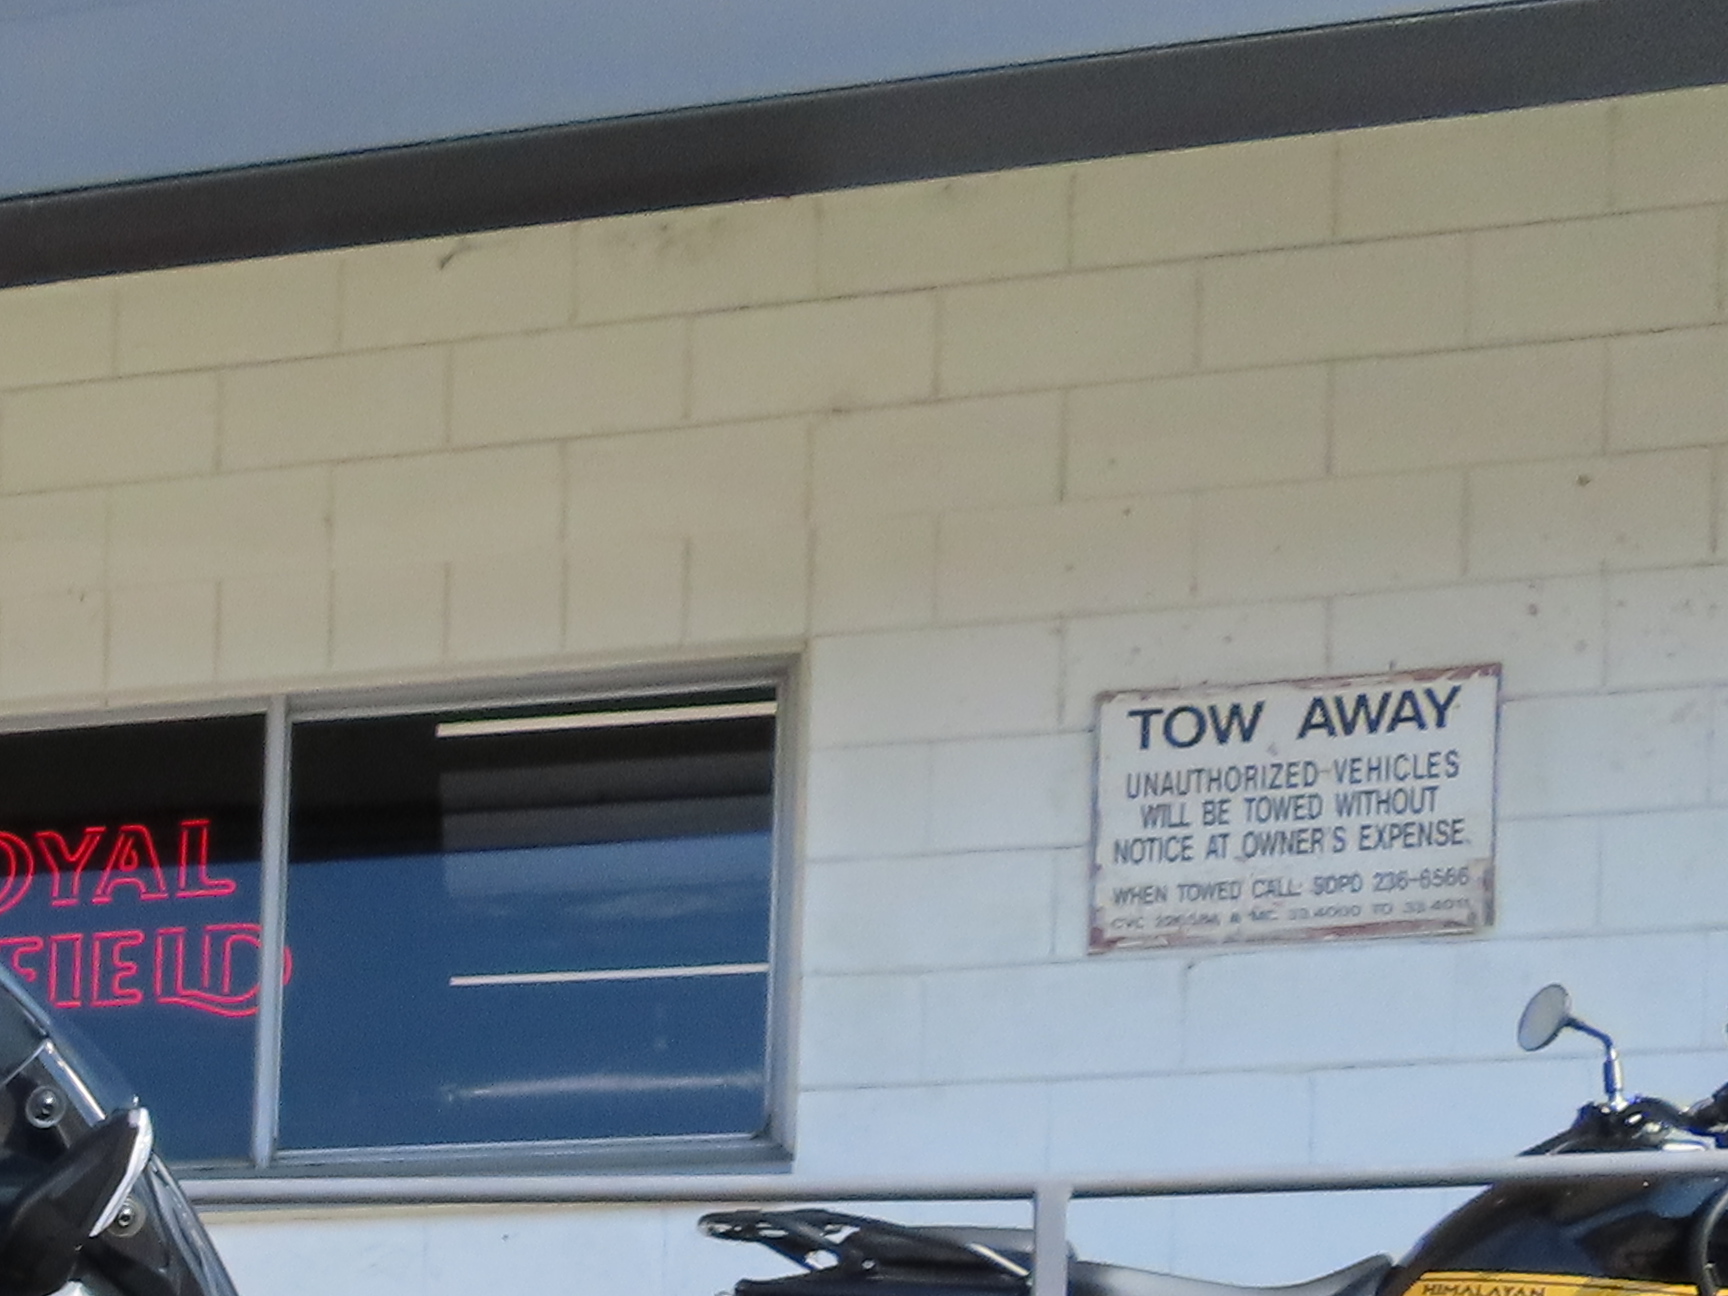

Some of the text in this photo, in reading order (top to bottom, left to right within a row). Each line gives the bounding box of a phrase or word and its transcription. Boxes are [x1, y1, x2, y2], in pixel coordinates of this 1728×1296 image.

[1128, 685, 1461, 749] TOW AWAY
[1126, 750, 1459, 799] UNAUTHORIZED VEHICLES
[1140, 785, 1439, 830] WILL BE TOWED WITHOUT
[1114, 836, 1194, 864] NOTICE
[1205, 834, 1228, 859] AT
[1244, 826, 1345, 859] OWNER'S
[1113, 884, 1168, 905] WHEN
[1177, 880, 1241, 902] TOWED
